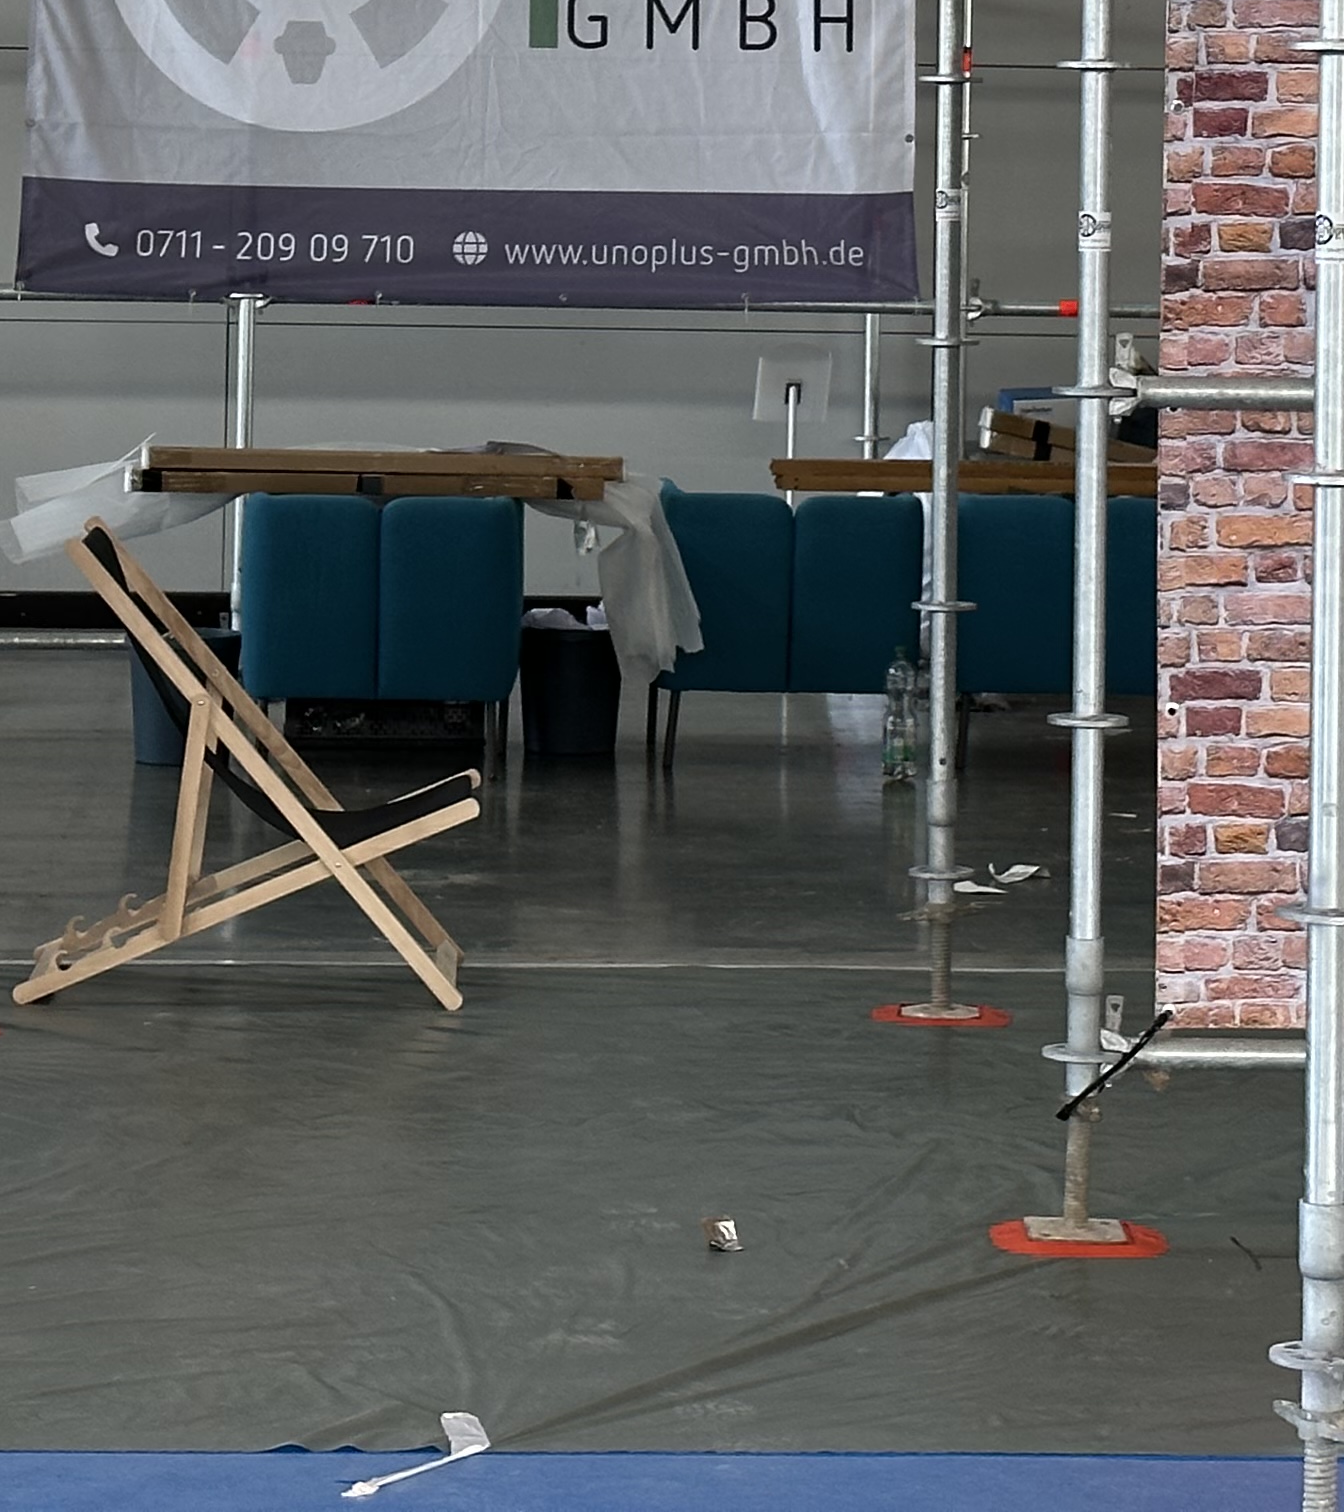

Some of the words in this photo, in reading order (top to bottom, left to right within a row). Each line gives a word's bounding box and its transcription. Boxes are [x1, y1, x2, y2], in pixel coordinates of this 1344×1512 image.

[136, 229, 202, 258] 0711
[236, 231, 296, 261] 209
[309, 233, 349, 263] 09
[361, 234, 414, 263] 710
[504, 238, 865, 274] www.unoplus-gmbh.de
